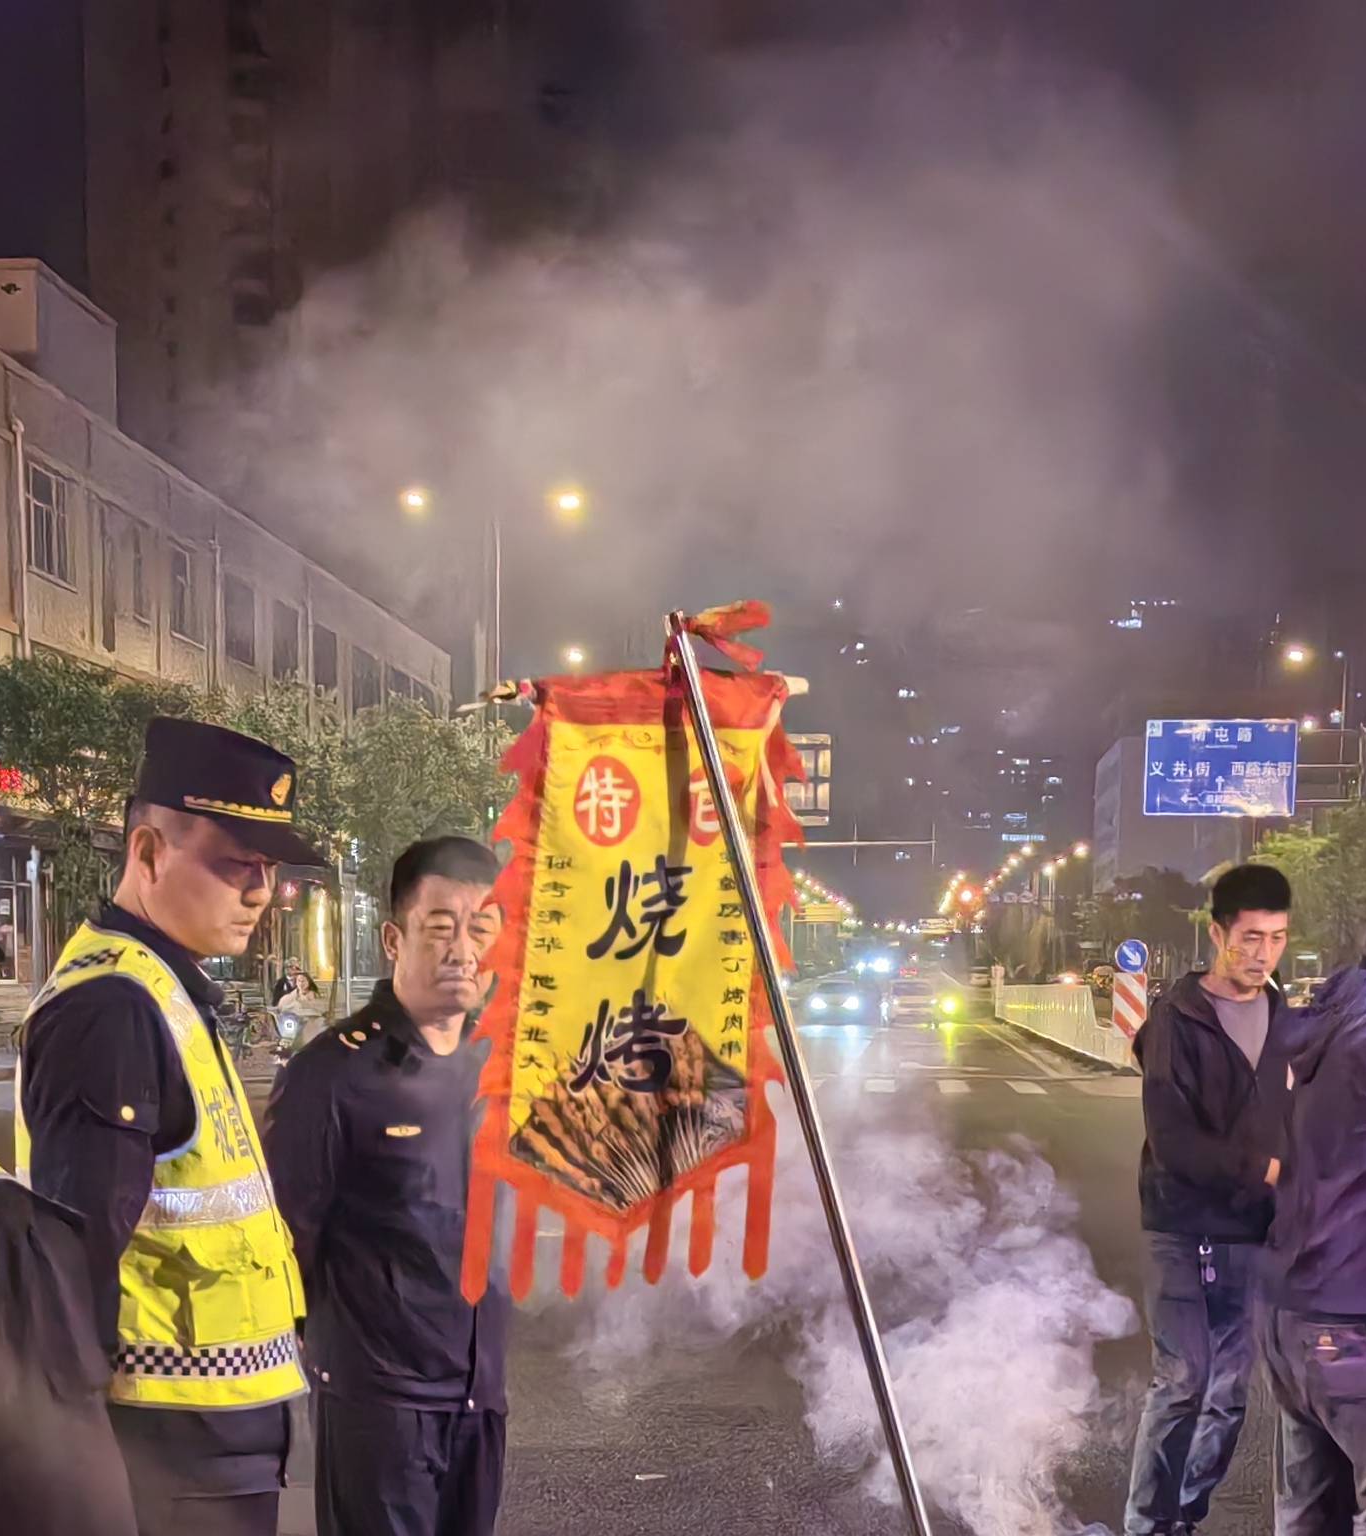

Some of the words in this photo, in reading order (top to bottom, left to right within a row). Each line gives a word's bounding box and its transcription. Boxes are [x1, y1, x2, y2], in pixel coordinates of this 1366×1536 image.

[1149, 761, 1211, 777] 义井街
[568, 853, 693, 1094] 烧烤
